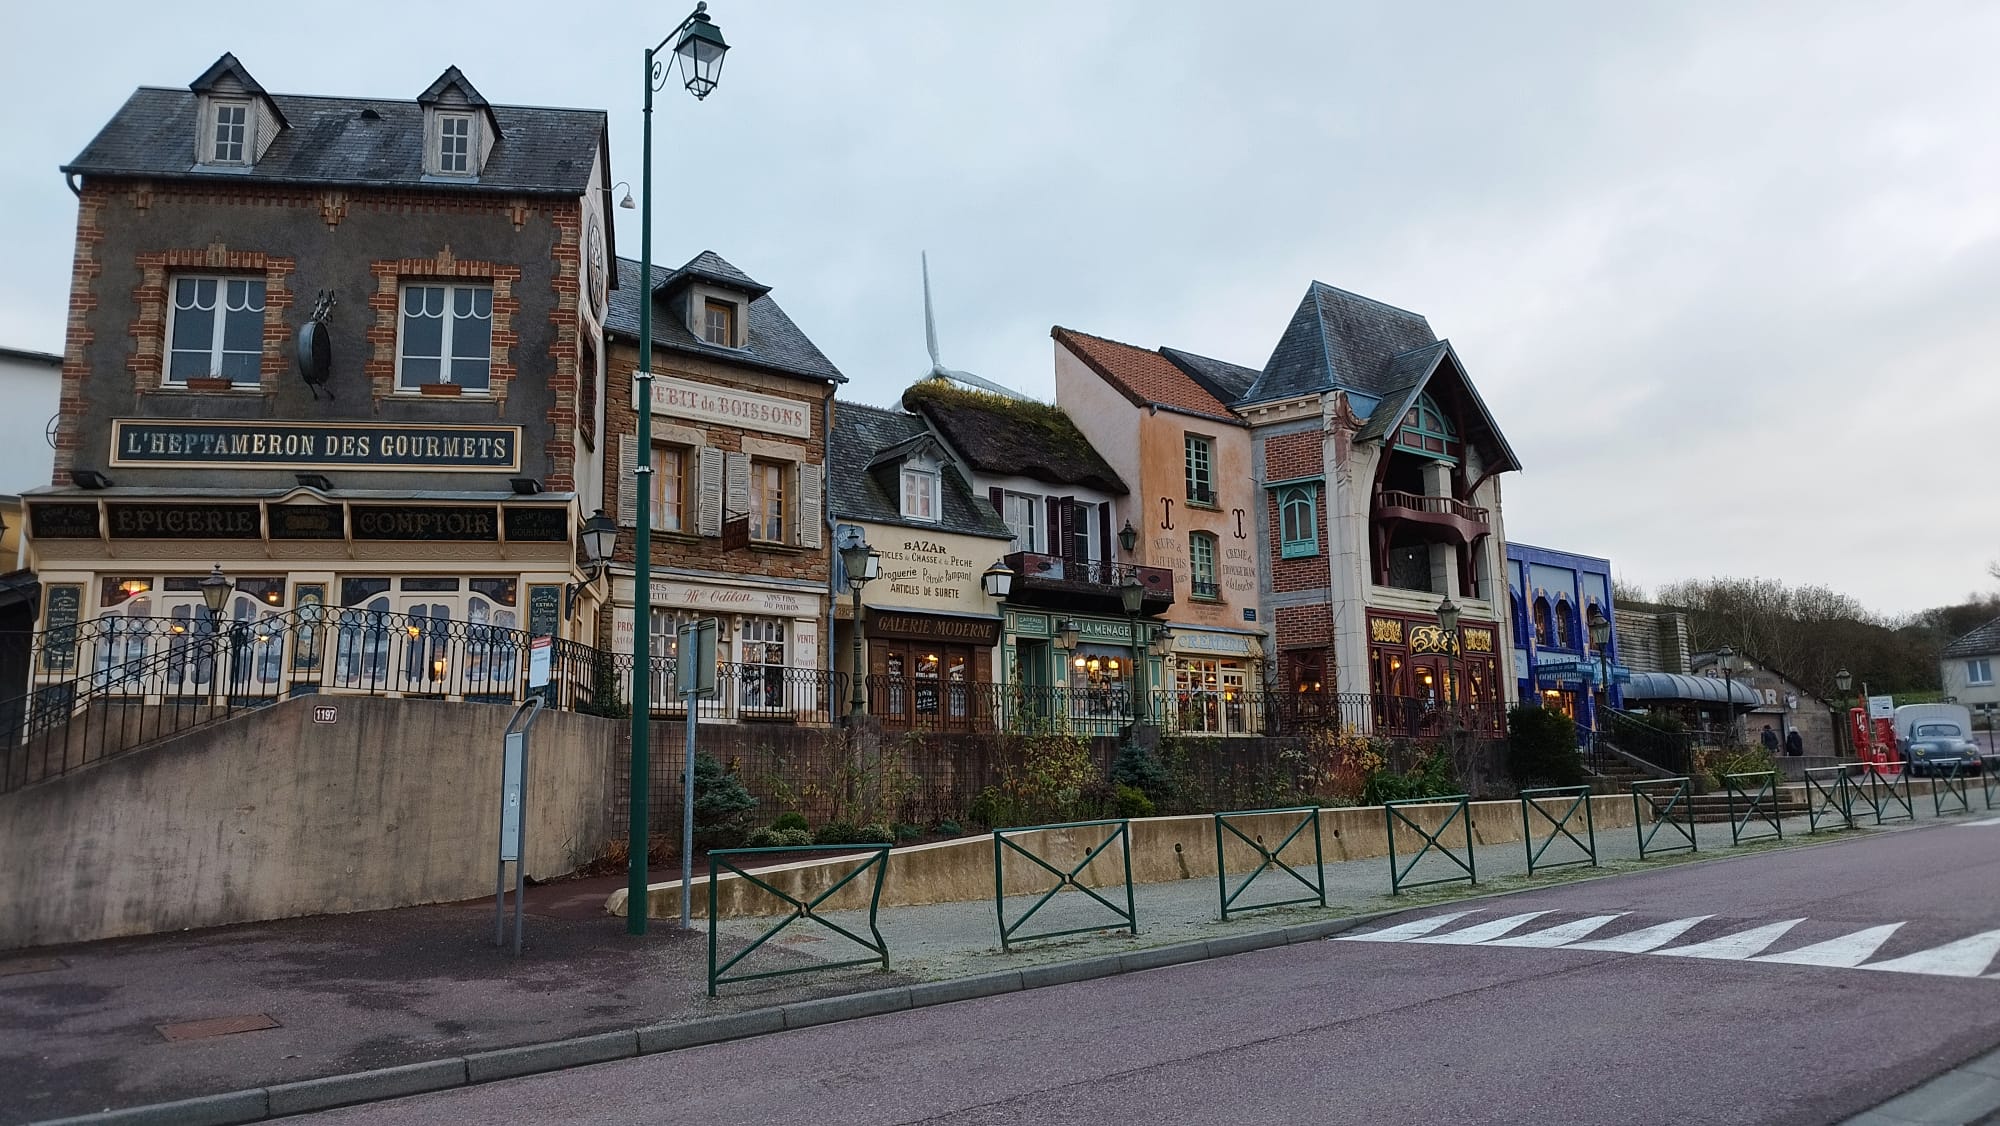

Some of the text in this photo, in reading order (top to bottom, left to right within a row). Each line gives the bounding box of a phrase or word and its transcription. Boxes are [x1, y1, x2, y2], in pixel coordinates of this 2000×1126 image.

[718, 396, 802, 427] BOISSONS
[127, 432, 506, 458] L'HEPTAMERON DES GOURMETS
[360, 512, 490, 534] COMPTOIR
[904, 541, 947, 554] BAZAR
[880, 551, 903, 561] TICLES
[911, 552, 938, 564] CHASSE
[877, 566, 917, 582] Droguerie
[890, 583, 919, 595] ARTICLES
[923, 586, 931, 596] DE
[617, 621, 634, 632] PRIX
[878, 616, 992, 638] GALERIE MODERNE
[1081, 622, 1092, 634] LA
[1094, 623, 1132, 637] MENAGE
[797, 634, 815, 645] VENTE
[1753, 688, 1778, 705] AR
[316, 709, 335, 721] 1197
